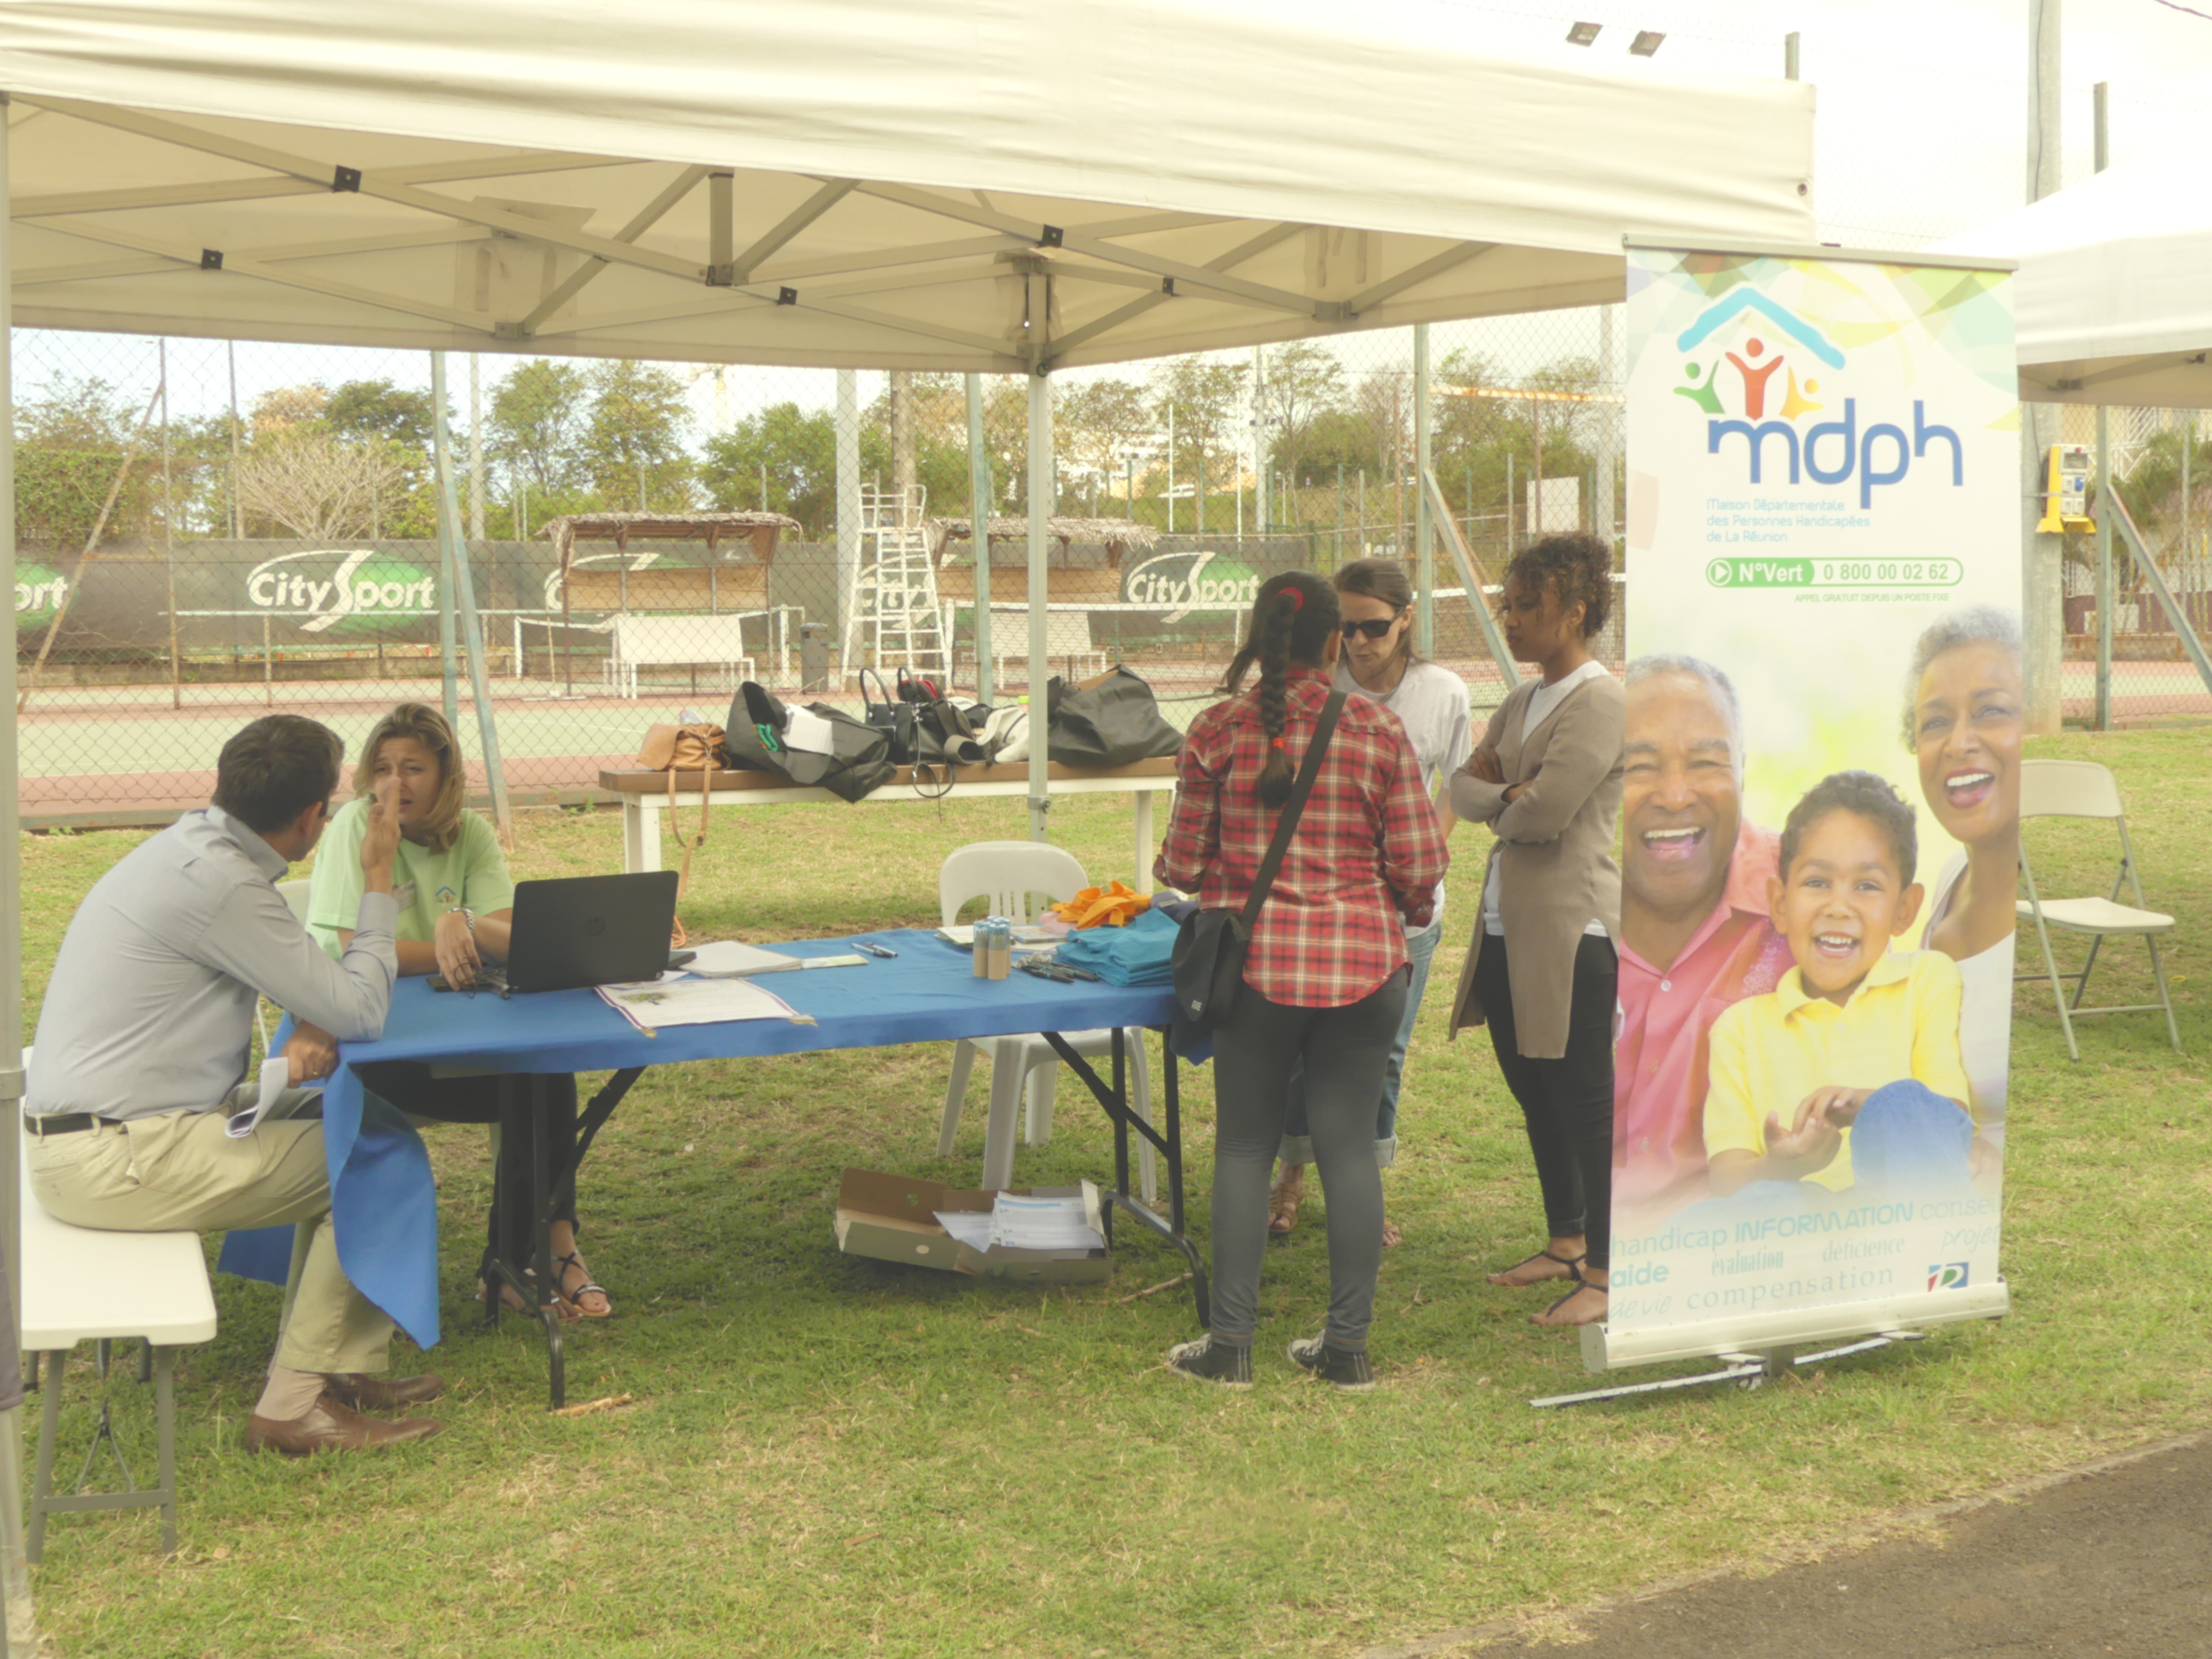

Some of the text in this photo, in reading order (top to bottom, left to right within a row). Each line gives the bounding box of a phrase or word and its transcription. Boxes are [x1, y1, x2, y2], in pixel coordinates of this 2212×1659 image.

[1708, 398, 1963, 509] mdph
[1707, 498, 1845, 513] Maison Départementale
[1707, 514, 1870, 529] des Personnes Handicapées
[1707, 531, 1787, 542] de La Réunion
[1824, 564, 1834, 580] 0
[1840, 564, 1871, 580] 800
[1877, 564, 1897, 580] 00
[1903, 564, 1922, 580] 02
[1928, 564, 1948, 580] 62
[1795, 593, 1950, 603] APPEL GRATUIT DEPUIS UN POSTE FIXE
[1610, 1227, 1728, 1258] handicap
[1735, 1201, 1914, 1243] INFORMATION
[1609, 1260, 1670, 1288] aide
[1711, 1246, 1785, 1276] évaluation
[1822, 1237, 1906, 1262] déficience
[1609, 1296, 1638, 1319] de
[1642, 1292, 1672, 1316] vie
[1687, 1266, 1893, 1310] compensation
